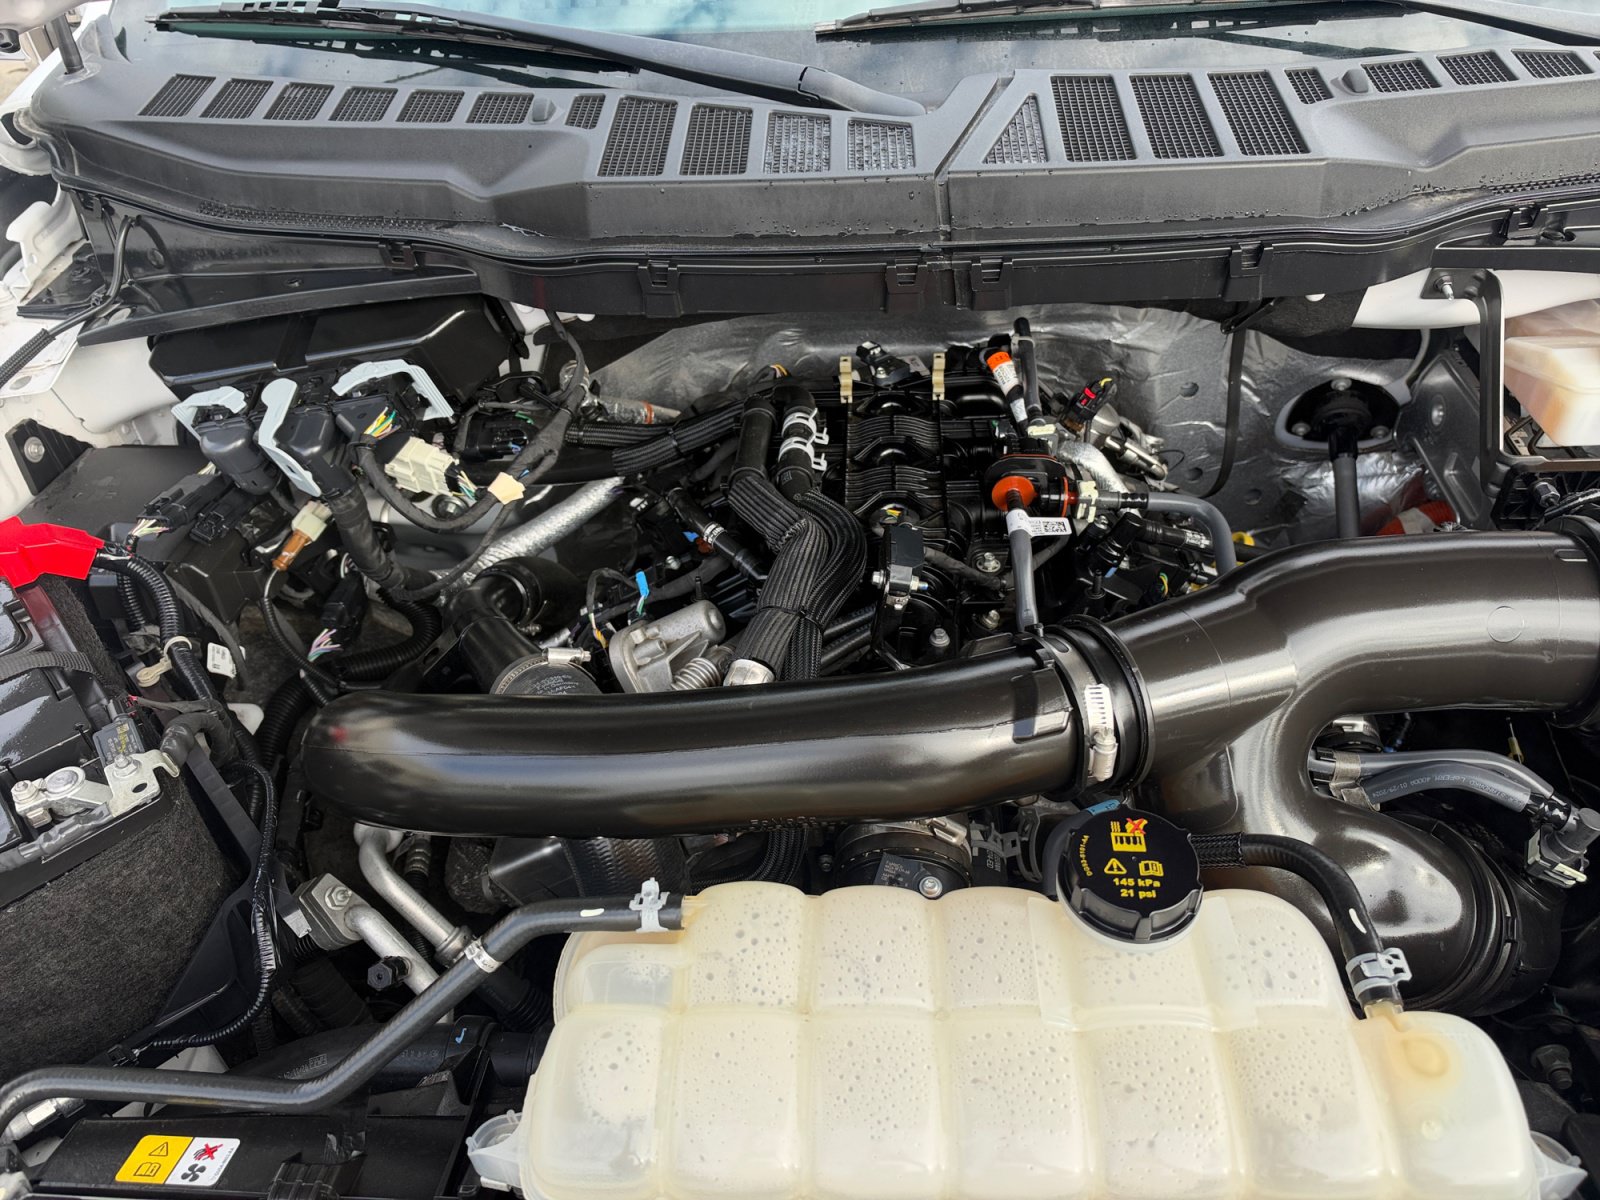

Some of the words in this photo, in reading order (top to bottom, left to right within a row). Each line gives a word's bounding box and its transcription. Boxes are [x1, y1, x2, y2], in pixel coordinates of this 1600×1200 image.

[1113, 877, 1135, 886] 145
[1138, 878, 1161, 887] kPa
[1120, 889, 1134, 897] 21
[1138, 890, 1156, 899] psi
